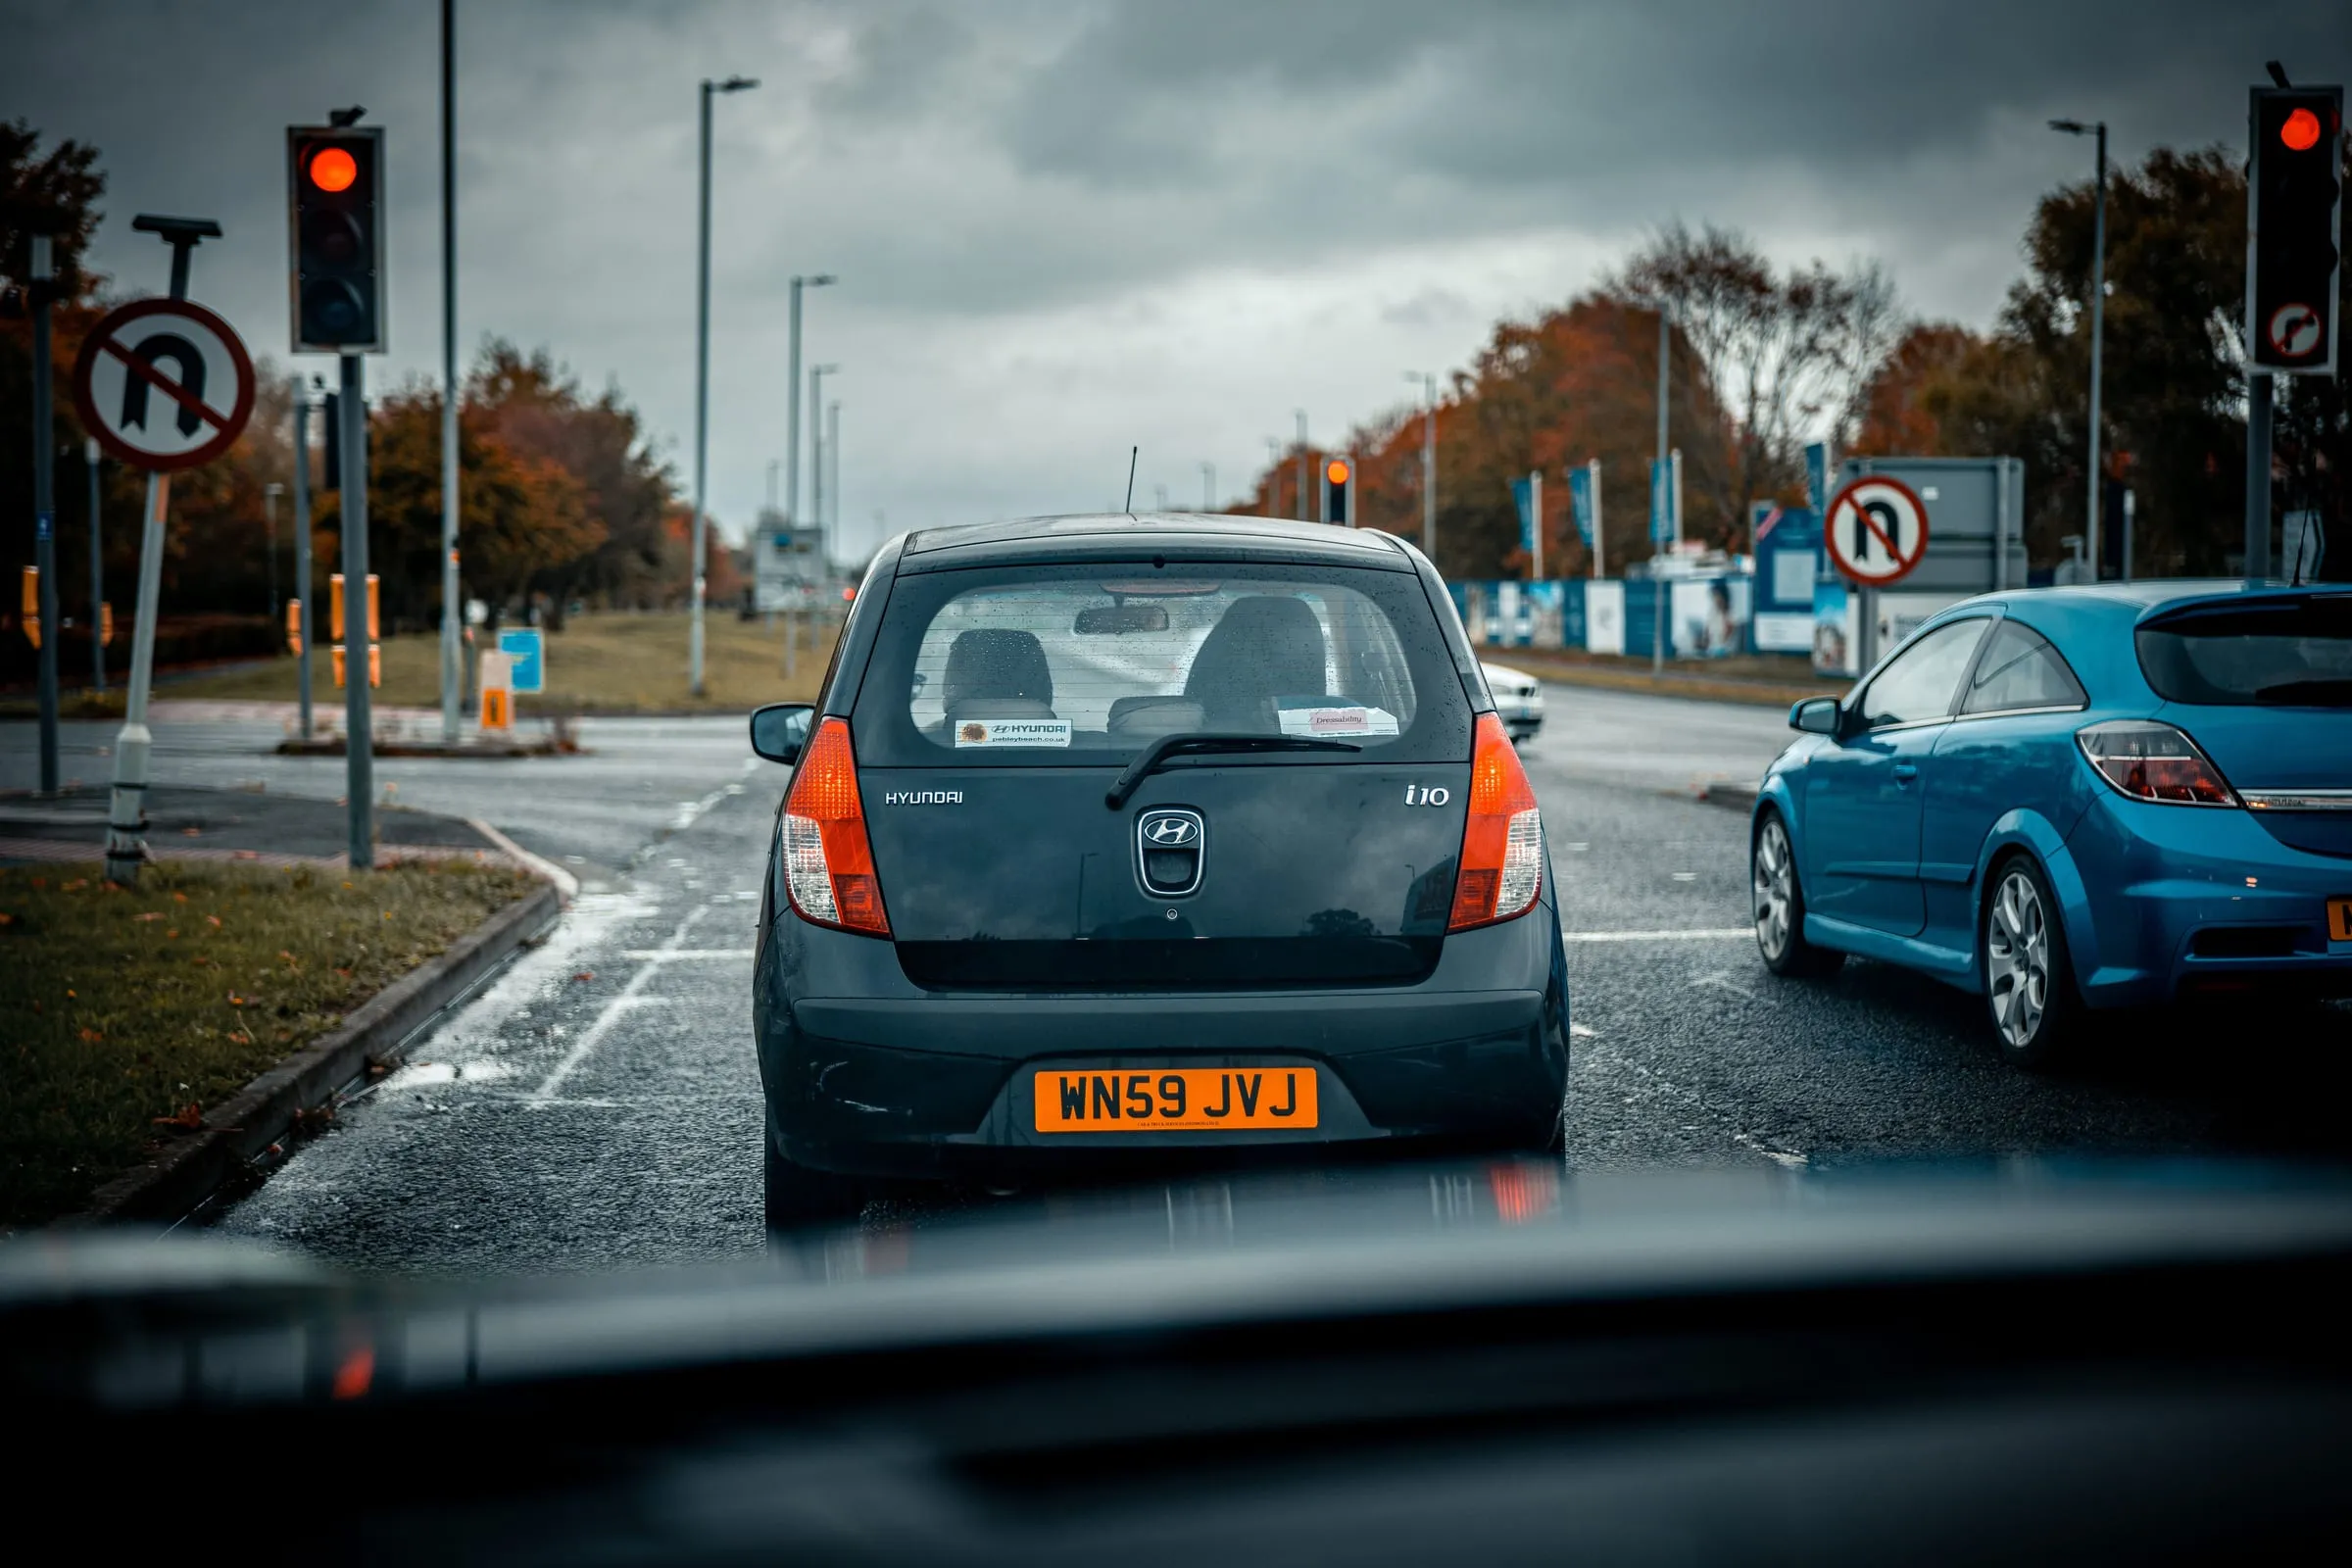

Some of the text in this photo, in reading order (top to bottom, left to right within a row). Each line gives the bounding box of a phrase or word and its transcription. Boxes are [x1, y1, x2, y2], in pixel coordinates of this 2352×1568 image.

[1316, 715, 1362, 725] Dressability
[1011, 724, 1066, 733] HYUNDAI
[886, 791, 963, 805] HYUNDAI
[1405, 784, 1449, 806] i10
[1059, 1073, 1297, 1120] WN59 JVJ
